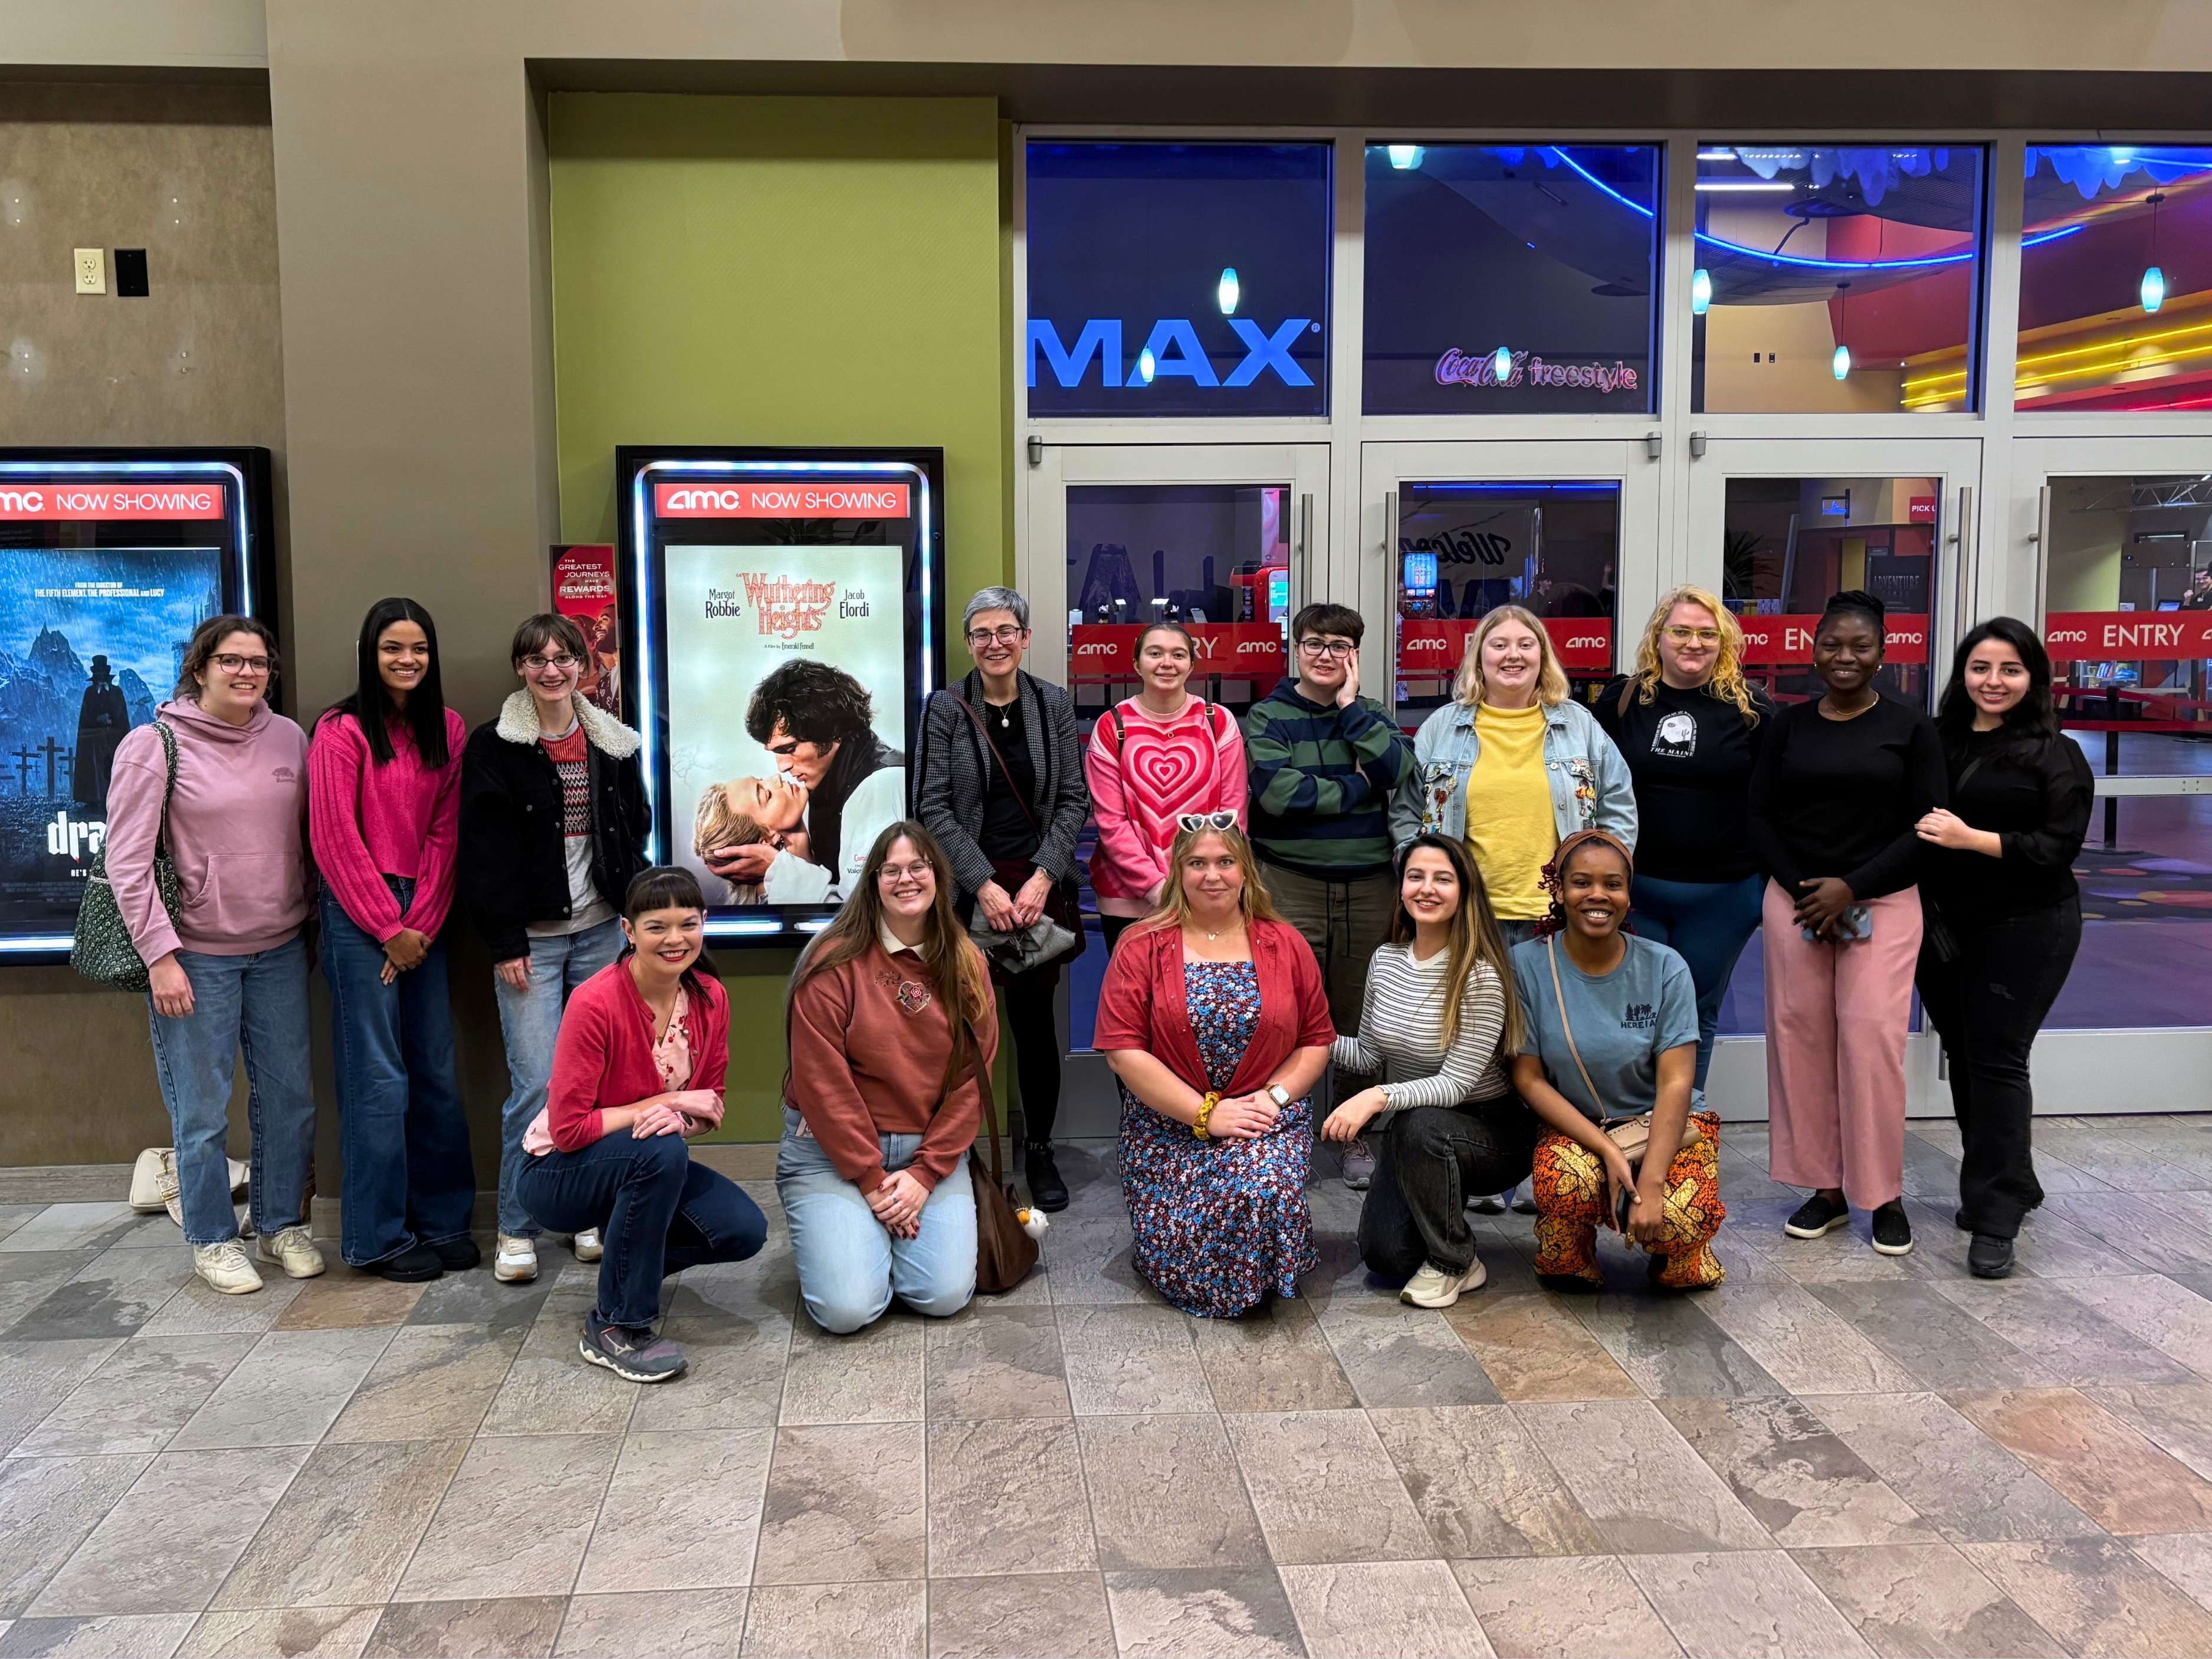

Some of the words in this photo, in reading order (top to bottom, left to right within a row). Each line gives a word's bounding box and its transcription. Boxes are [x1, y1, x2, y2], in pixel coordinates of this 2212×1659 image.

[1528, 357, 1637, 393] freestyle
[0, 491, 44, 512] mc
[57, 493, 109, 510] NOW
[113, 493, 211, 510] SHOWING
[667, 490, 740, 510] amc
[752, 492, 801, 509] NOW
[805, 492, 897, 509] SHOWING
[35, 589, 45, 597] THE
[46, 589, 61, 597] FIFTH
[99, 589, 140, 597] PROFESSIONAL
[150, 589, 165, 597] LUCY
[709, 589, 736, 602] Margot
[844, 589, 865, 601] Jacob
[705, 601, 741, 619] Robbie
[839, 601, 869, 619] Elordi
[1742, 633, 1768, 645] mc
[1885, 632, 1922, 644] amc
[2047, 630, 2087, 642] amc
[2103, 623, 2185, 647] ENTRY
[1077, 643, 1118, 655] amc
[1236, 641, 1277, 653] amc
[1406, 638, 1447, 651] amc
[1566, 636, 1606, 649] amc
[71, 869, 87, 877] HE'S
